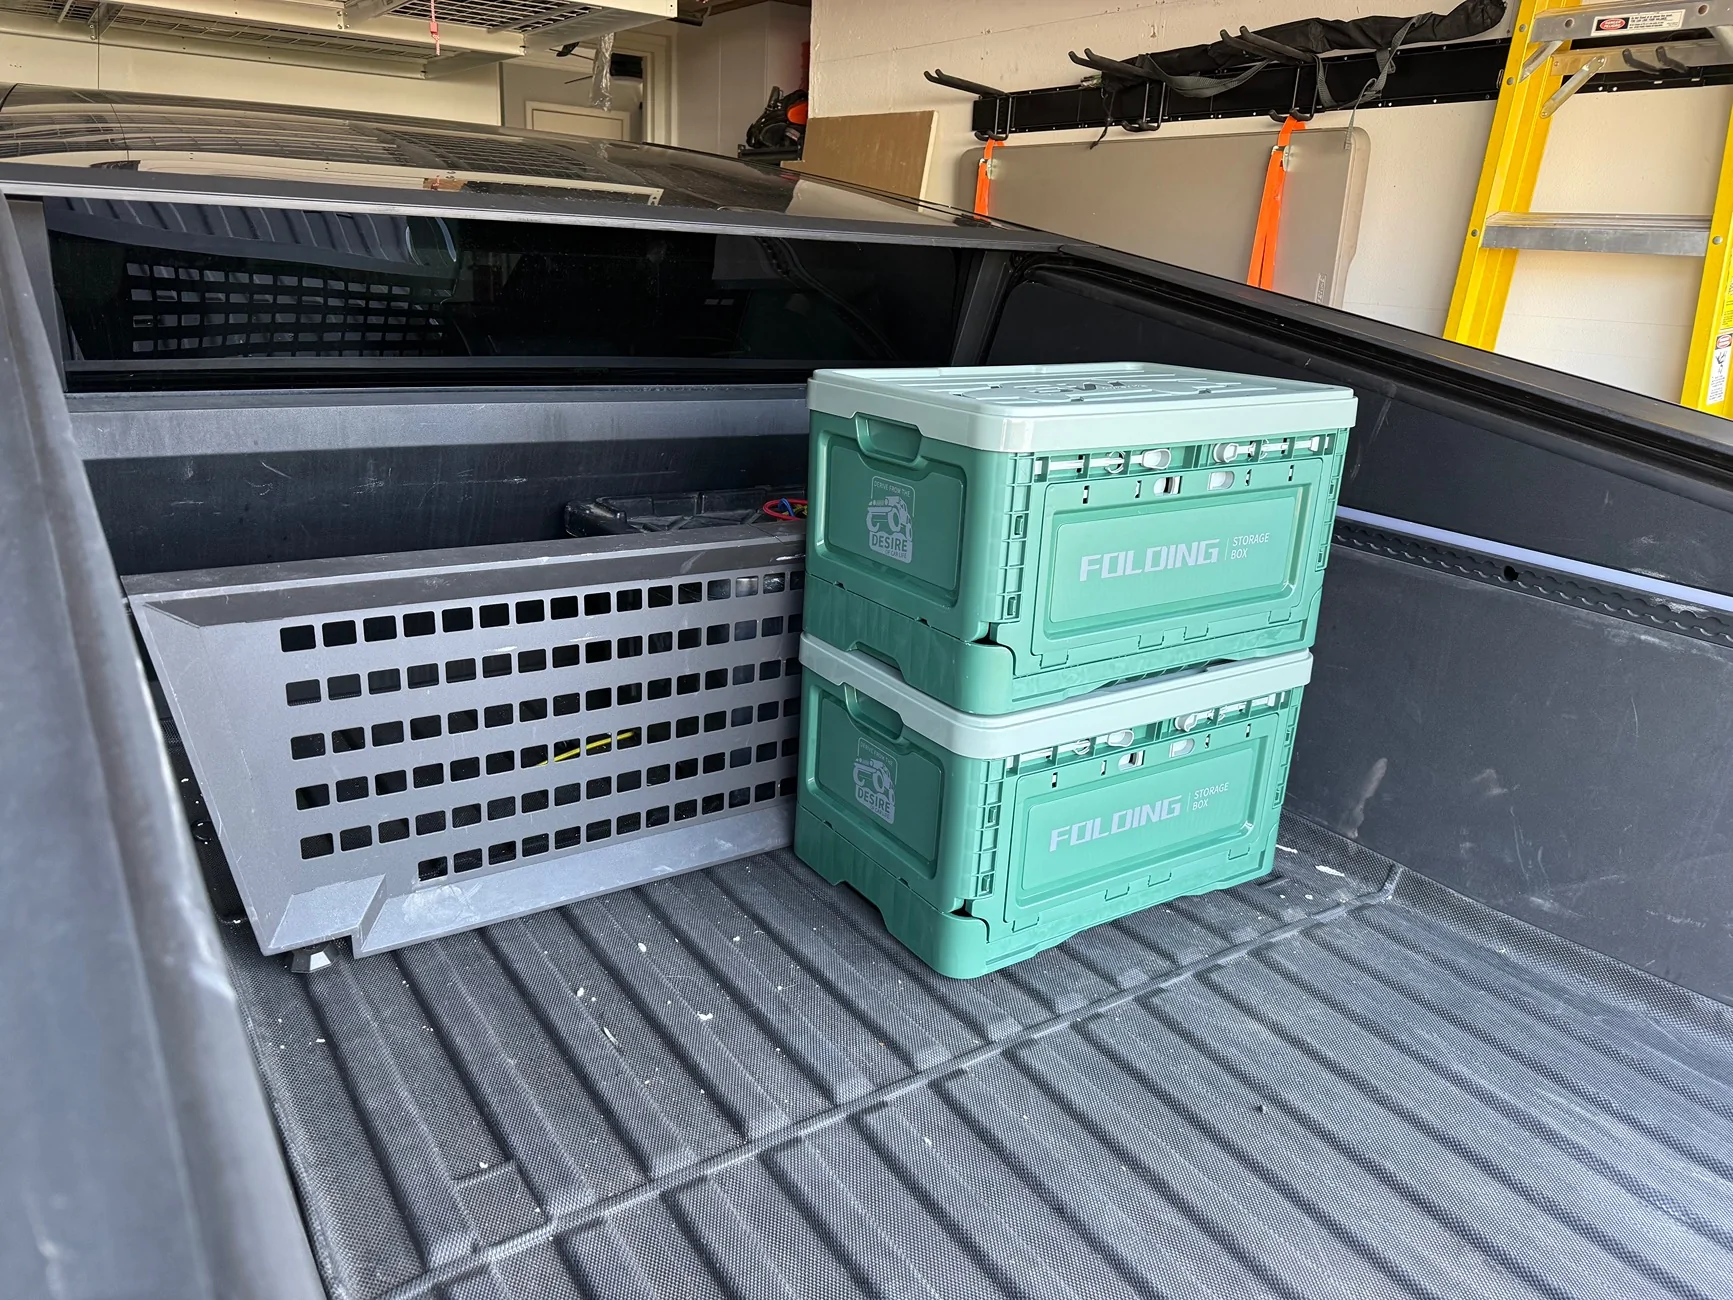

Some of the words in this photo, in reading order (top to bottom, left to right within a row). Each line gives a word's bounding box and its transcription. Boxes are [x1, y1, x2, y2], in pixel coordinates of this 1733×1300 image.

[874, 480, 889, 491] DERIVE
[889, 485, 901, 494] FROM
[901, 489, 911, 497] THE
[871, 533, 908, 553] DESIRE
[1079, 538, 1220, 582] FOLDING
[1232, 532, 1270, 547] STORAGE
[1231, 547, 1248, 560] BOX
[858, 787, 890, 813] DESIRE
[1192, 798, 1209, 811] BOX
[1049, 795, 1183, 852] FOLDING
[1194, 782, 1229, 799] STORAGE
